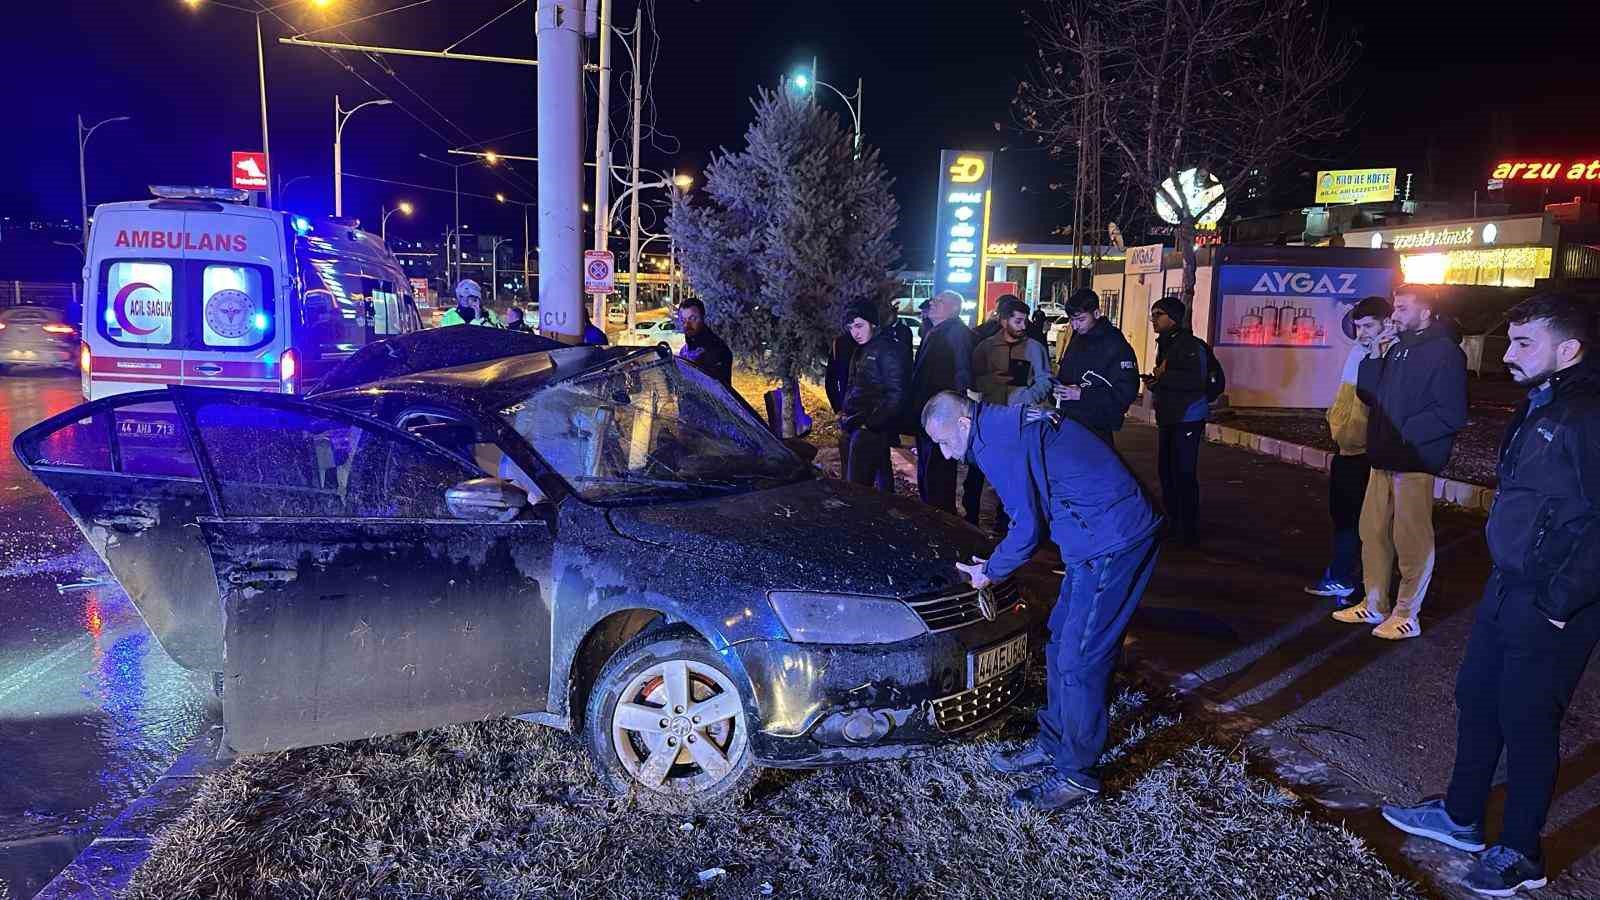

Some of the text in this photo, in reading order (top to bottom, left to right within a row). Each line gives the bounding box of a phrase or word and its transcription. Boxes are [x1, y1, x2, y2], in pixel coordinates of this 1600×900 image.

[1492, 160, 1600, 180] arzu at
[114, 229, 247, 252] AMBULANS
[1251, 271, 1358, 294] AYGAZ
[146, 298, 172, 317] SAĞLIK
[121, 423, 132, 433] 44
